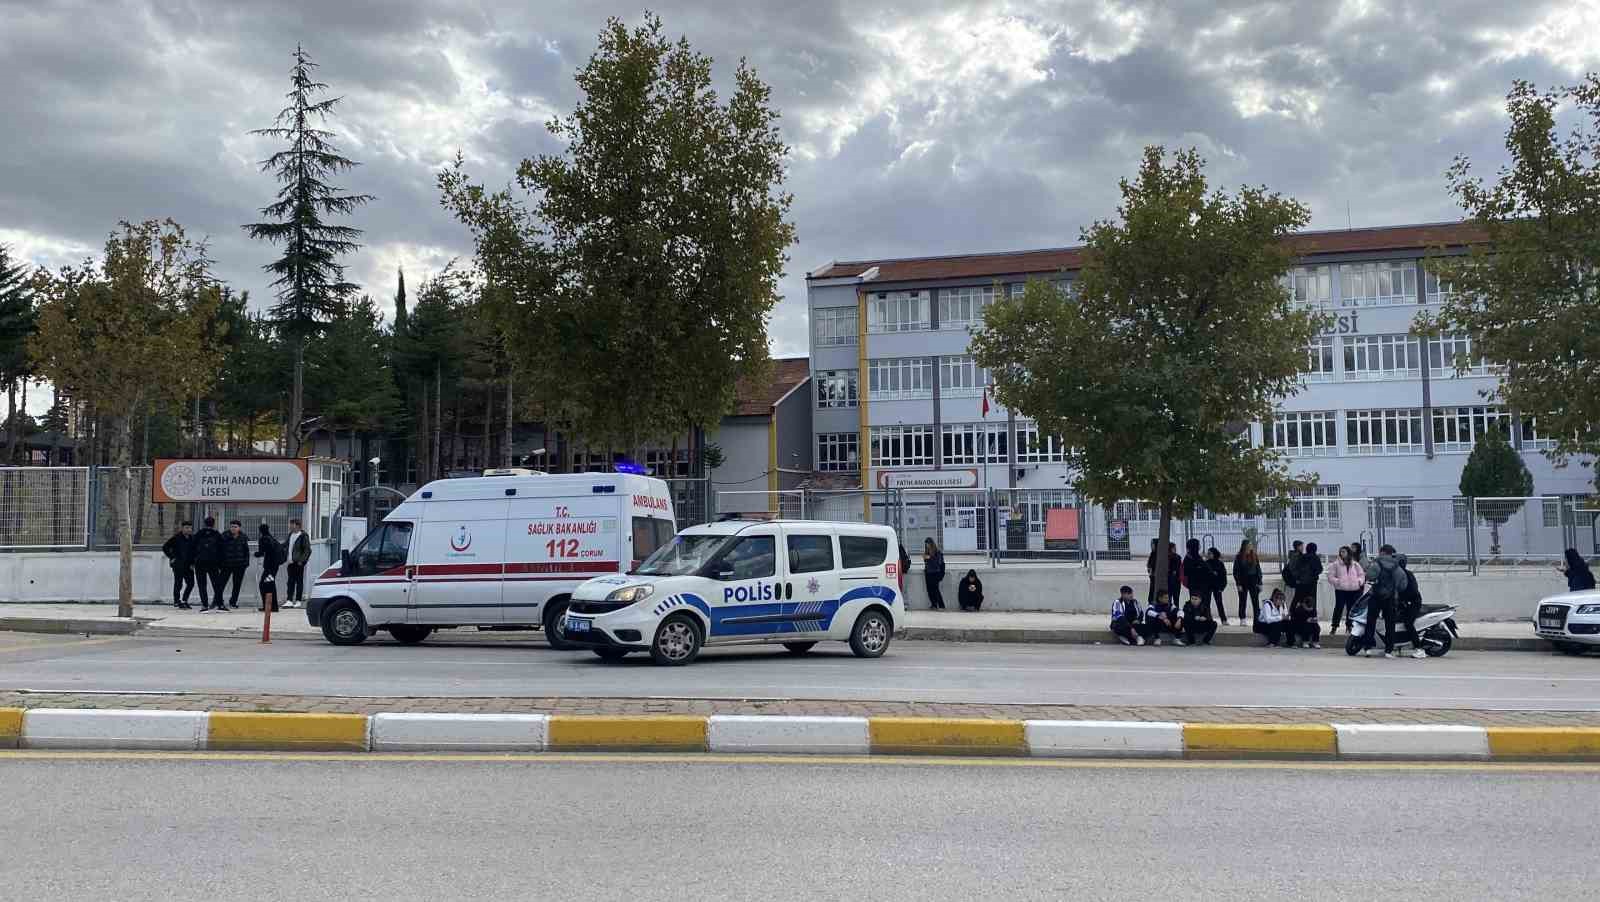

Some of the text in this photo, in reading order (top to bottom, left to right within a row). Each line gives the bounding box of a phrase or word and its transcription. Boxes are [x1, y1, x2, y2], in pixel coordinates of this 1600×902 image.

[201, 475, 279, 485] FATİH ANADOLU
[201, 485, 230, 497] LİSESİ
[632, 494, 668, 511] AMBULANS
[555, 506, 570, 518] T.C.
[528, 519, 597, 535] SAĞLIK BAKANLIĞI
[546, 539, 578, 558] 112
[724, 581, 772, 603] POLİS
